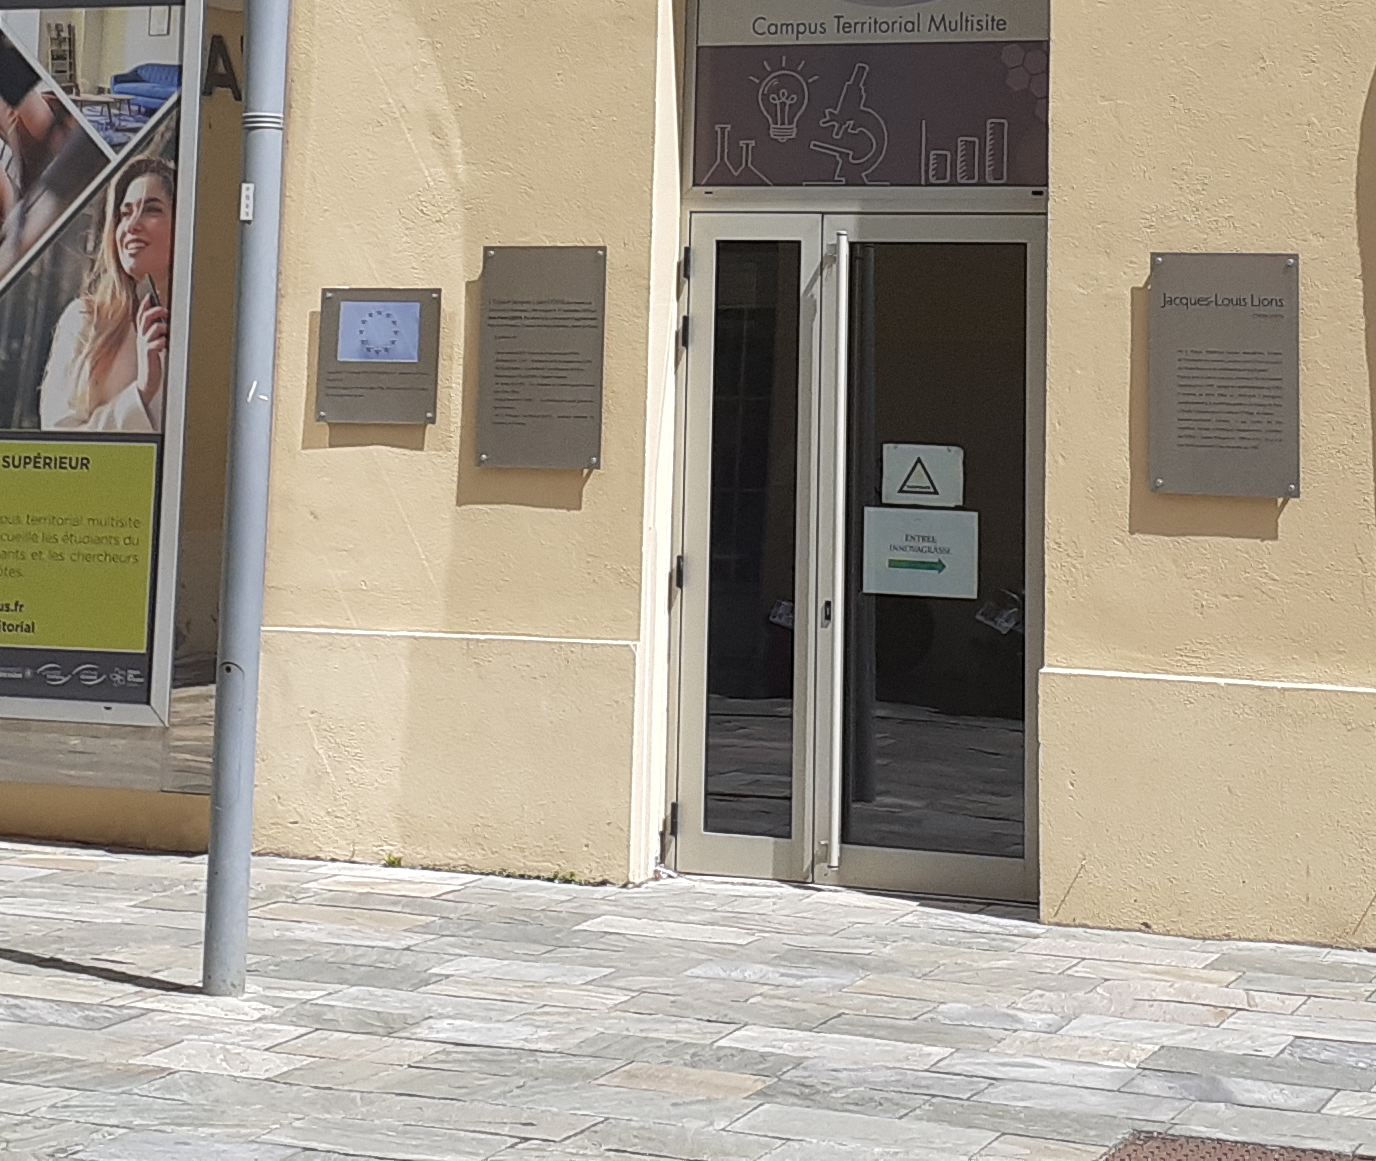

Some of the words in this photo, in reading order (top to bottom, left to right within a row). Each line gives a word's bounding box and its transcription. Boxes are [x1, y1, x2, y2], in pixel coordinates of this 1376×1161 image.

[752, 17, 826, 39] Campus
[834, 13, 921, 35] Territorial
[928, 12, 1007, 33] Multisite
[1161, 292, 1247, 309] Jacques-Louis
[1251, 293, 1284, 308] Lions
[2, 453, 91, 471] SUPÉRIEUR
